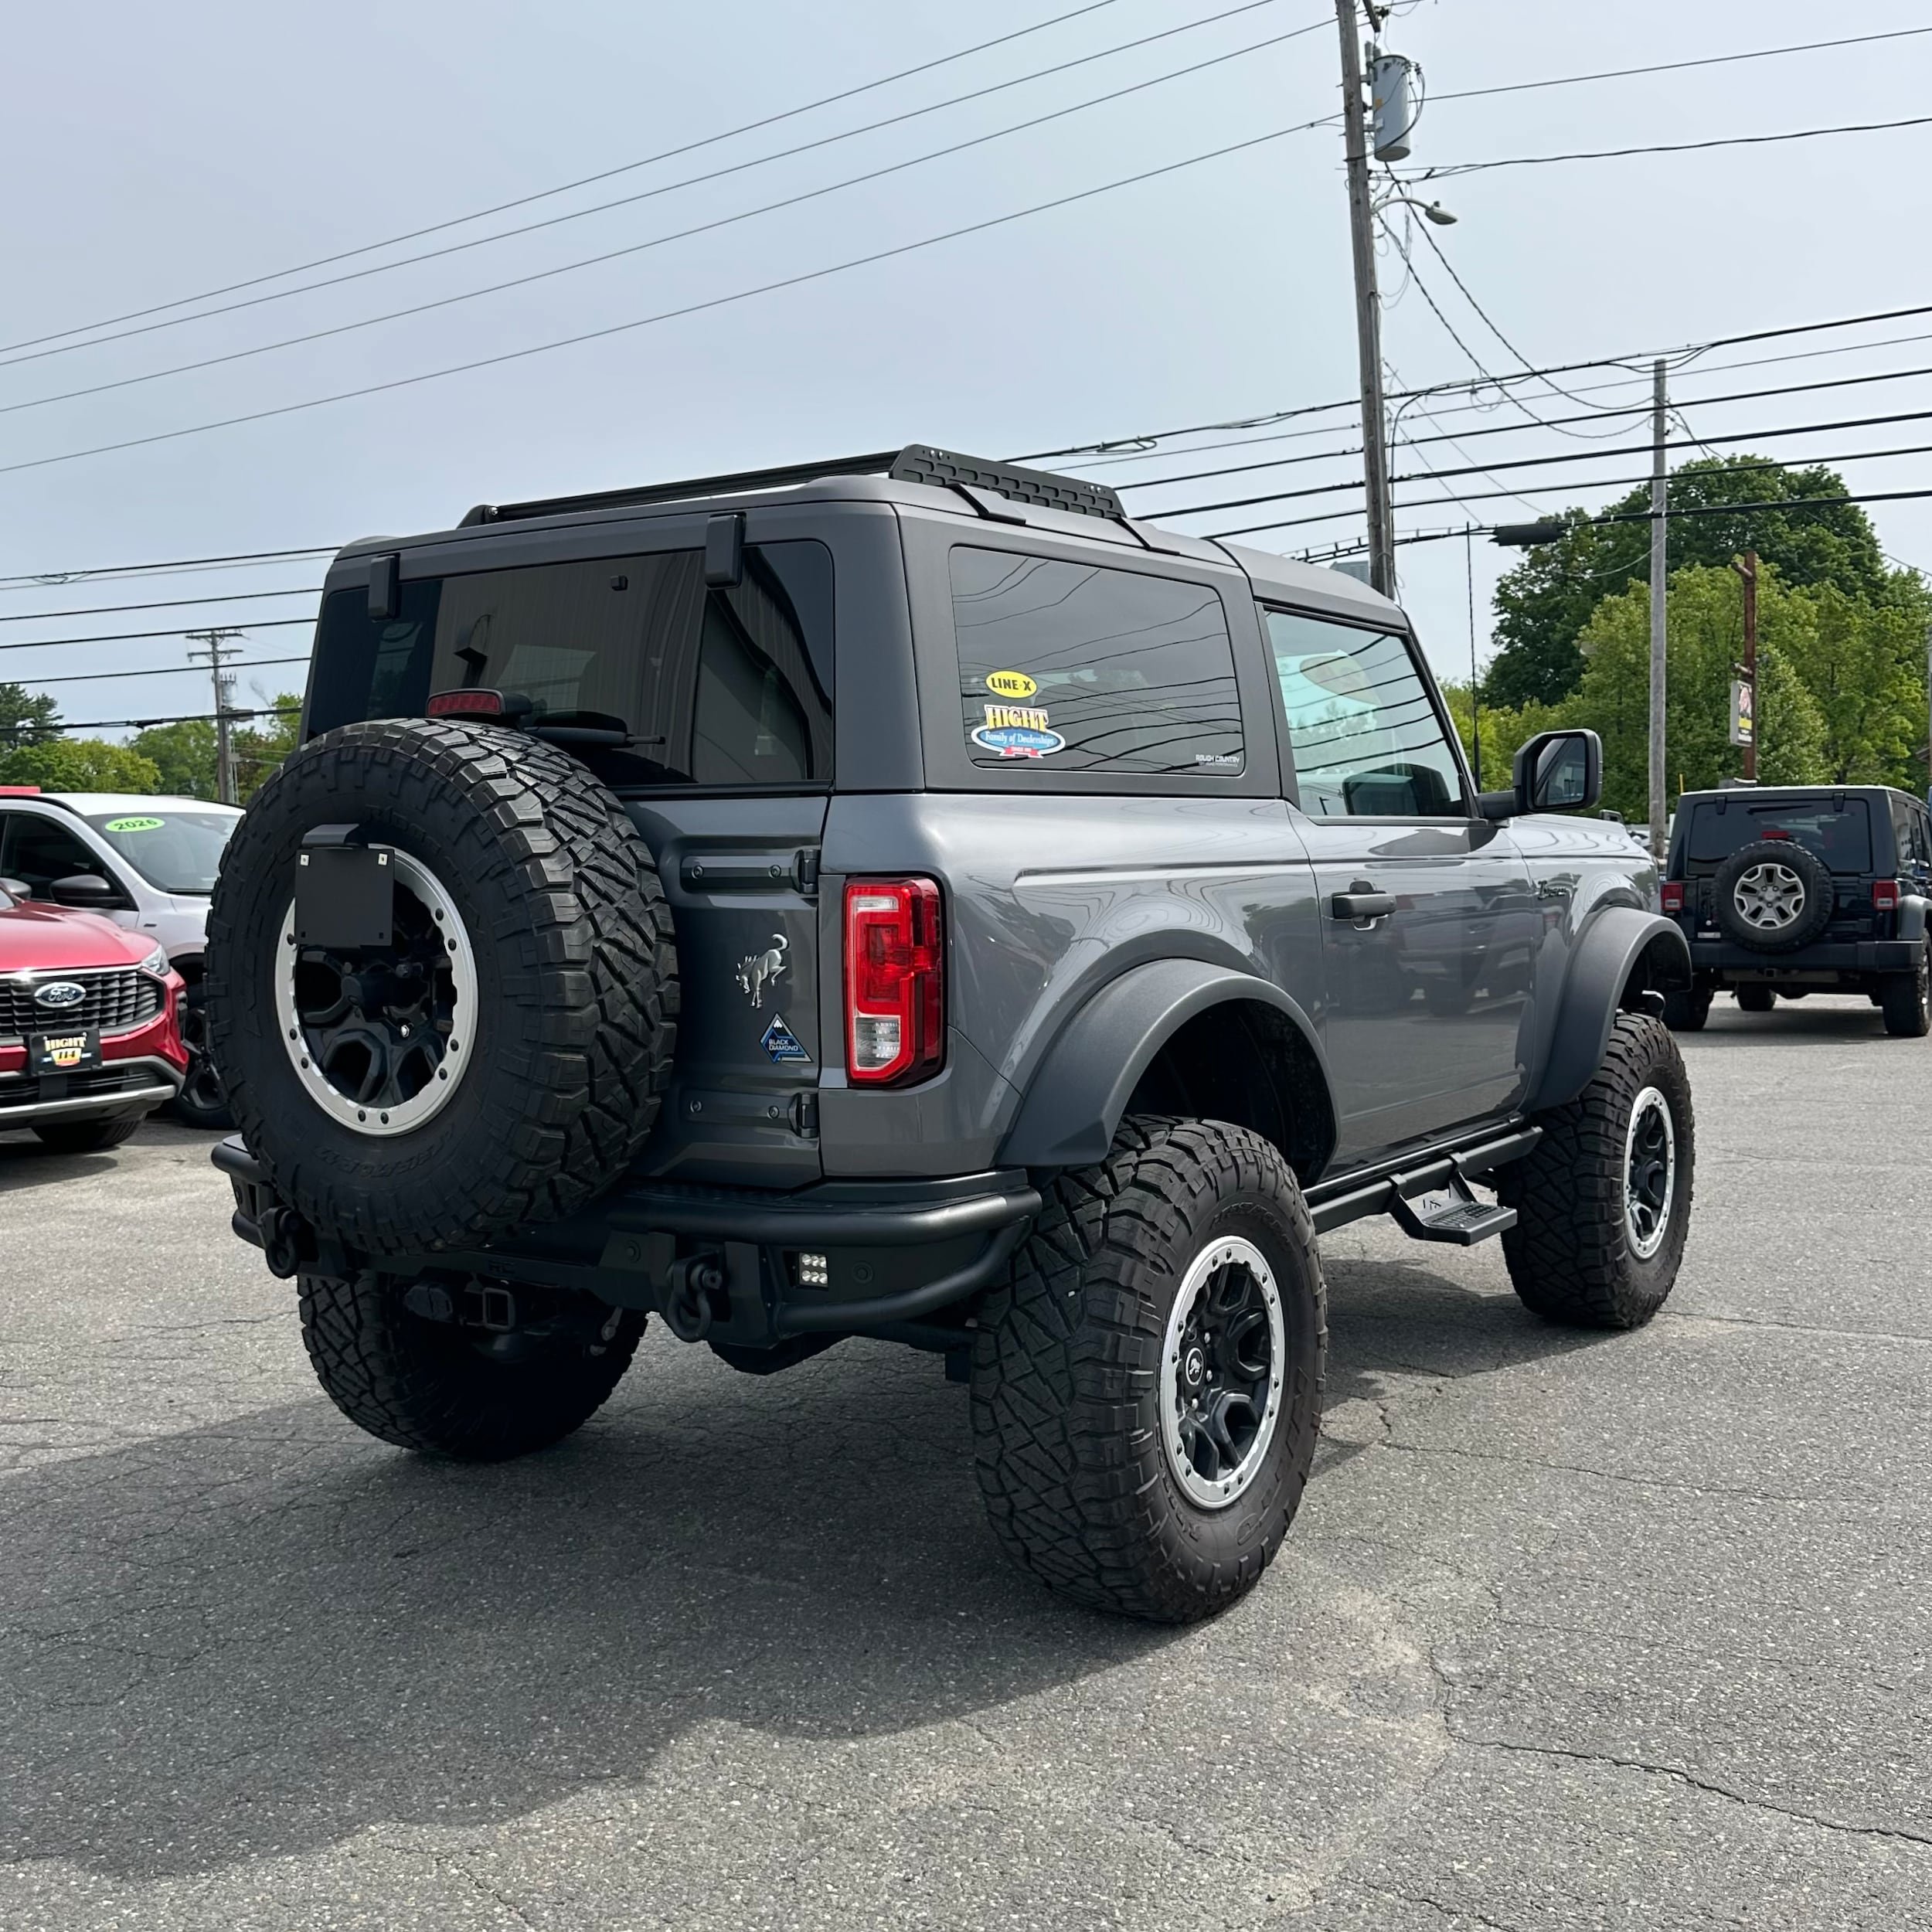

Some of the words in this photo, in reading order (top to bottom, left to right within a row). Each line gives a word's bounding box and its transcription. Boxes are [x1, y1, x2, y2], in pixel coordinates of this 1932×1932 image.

[986, 706, 1048, 732] HIGHT
[985, 731, 1007, 744] Family
[1009, 733, 1017, 745] of
[114, 819, 158, 830] 2026
[49, 987, 76, 1002] Ford
[45, 1036, 87, 1052] HIGHT
